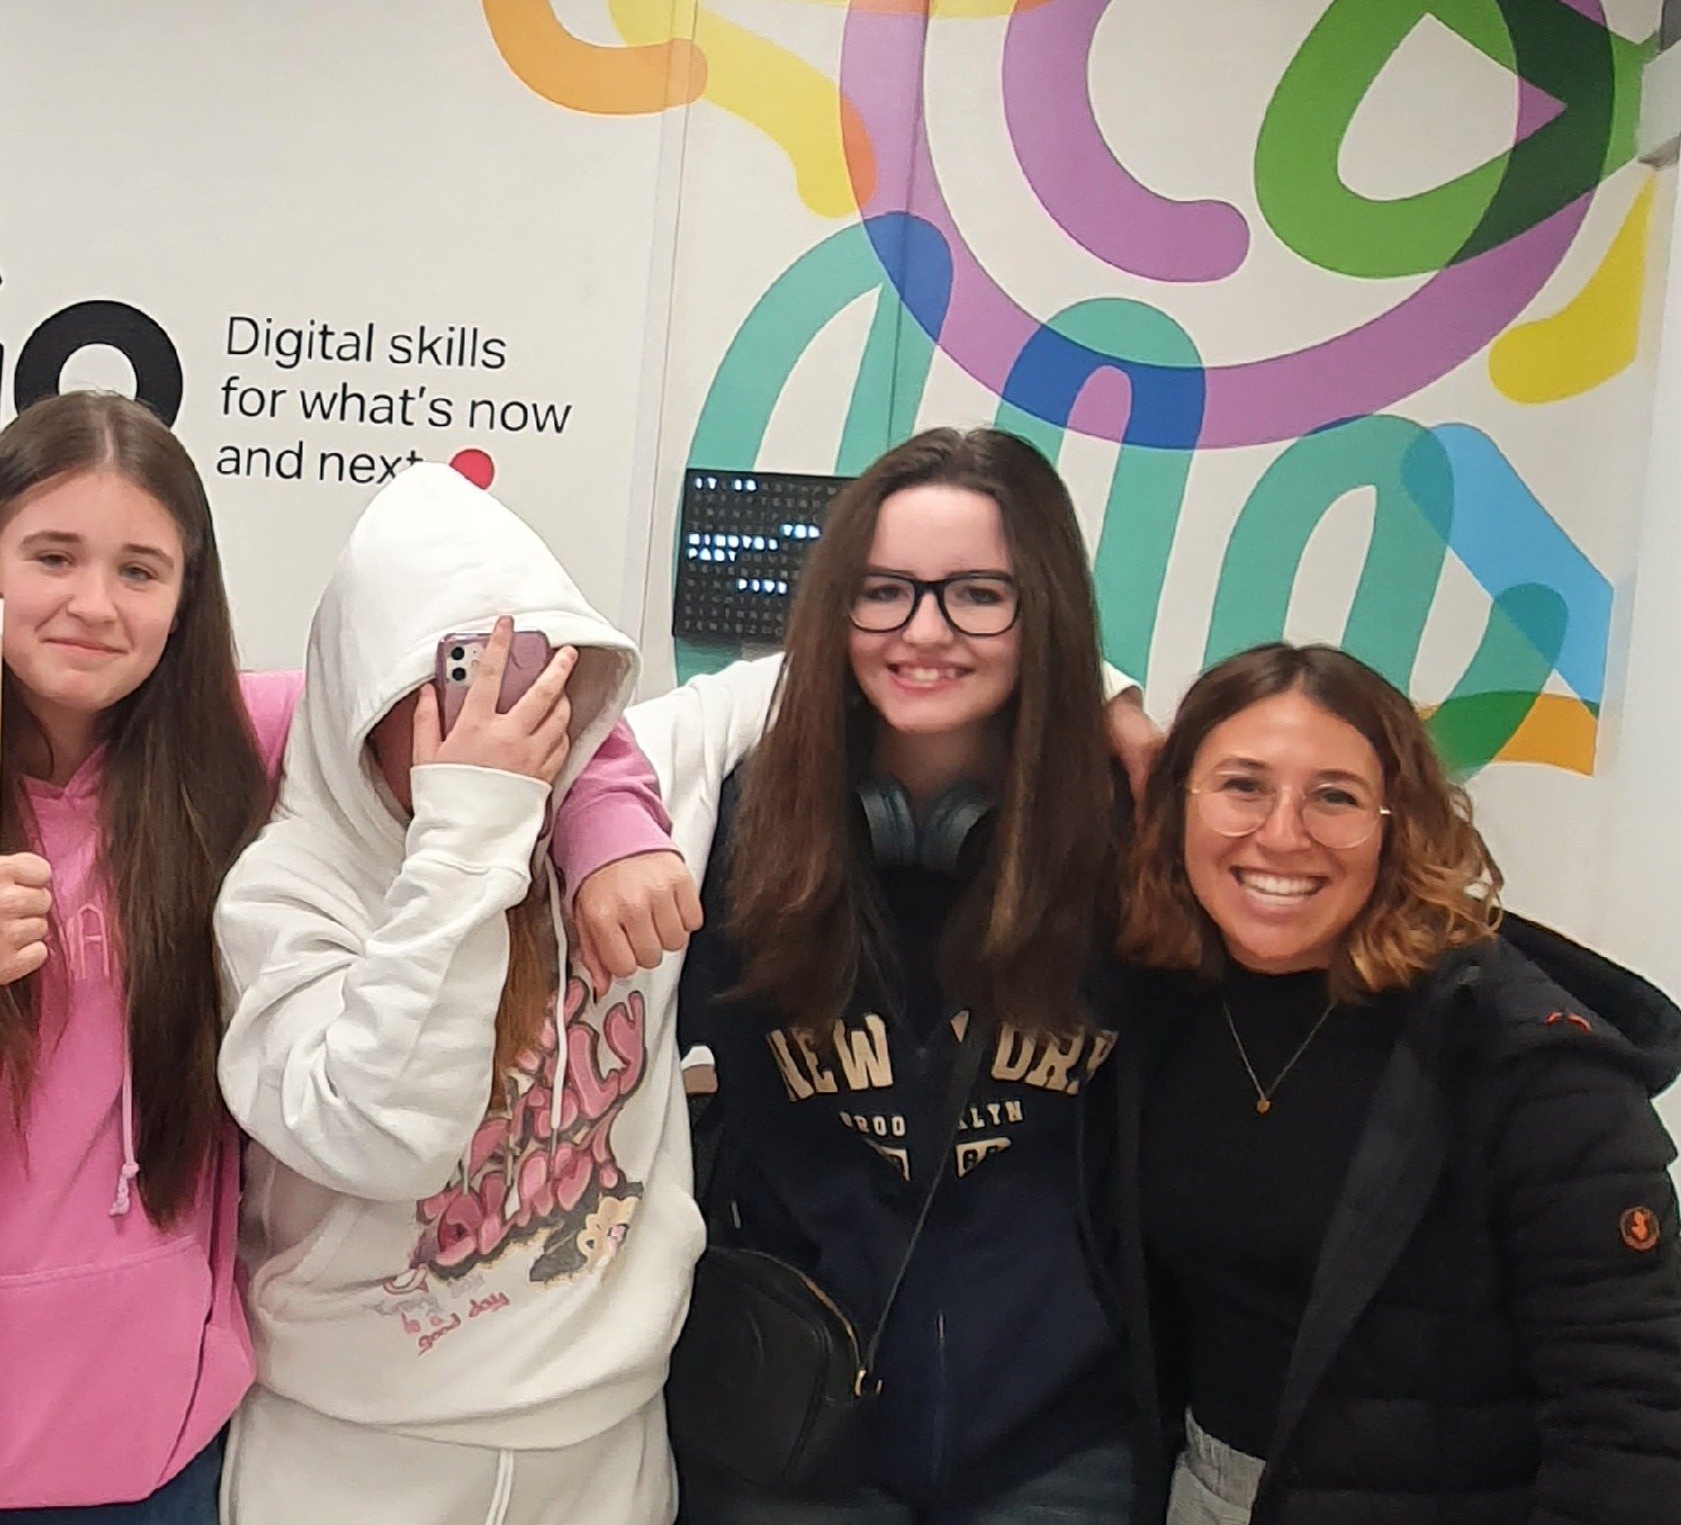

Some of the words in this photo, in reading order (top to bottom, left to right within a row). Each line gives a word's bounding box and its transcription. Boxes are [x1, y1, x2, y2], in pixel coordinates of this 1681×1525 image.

[225, 315, 374, 369] Digital
[387, 325, 507, 369] skills
[220, 377, 287, 419] for
[299, 381, 453, 428] what's
[468, 398, 573, 435] now
[215, 440, 304, 482] and
